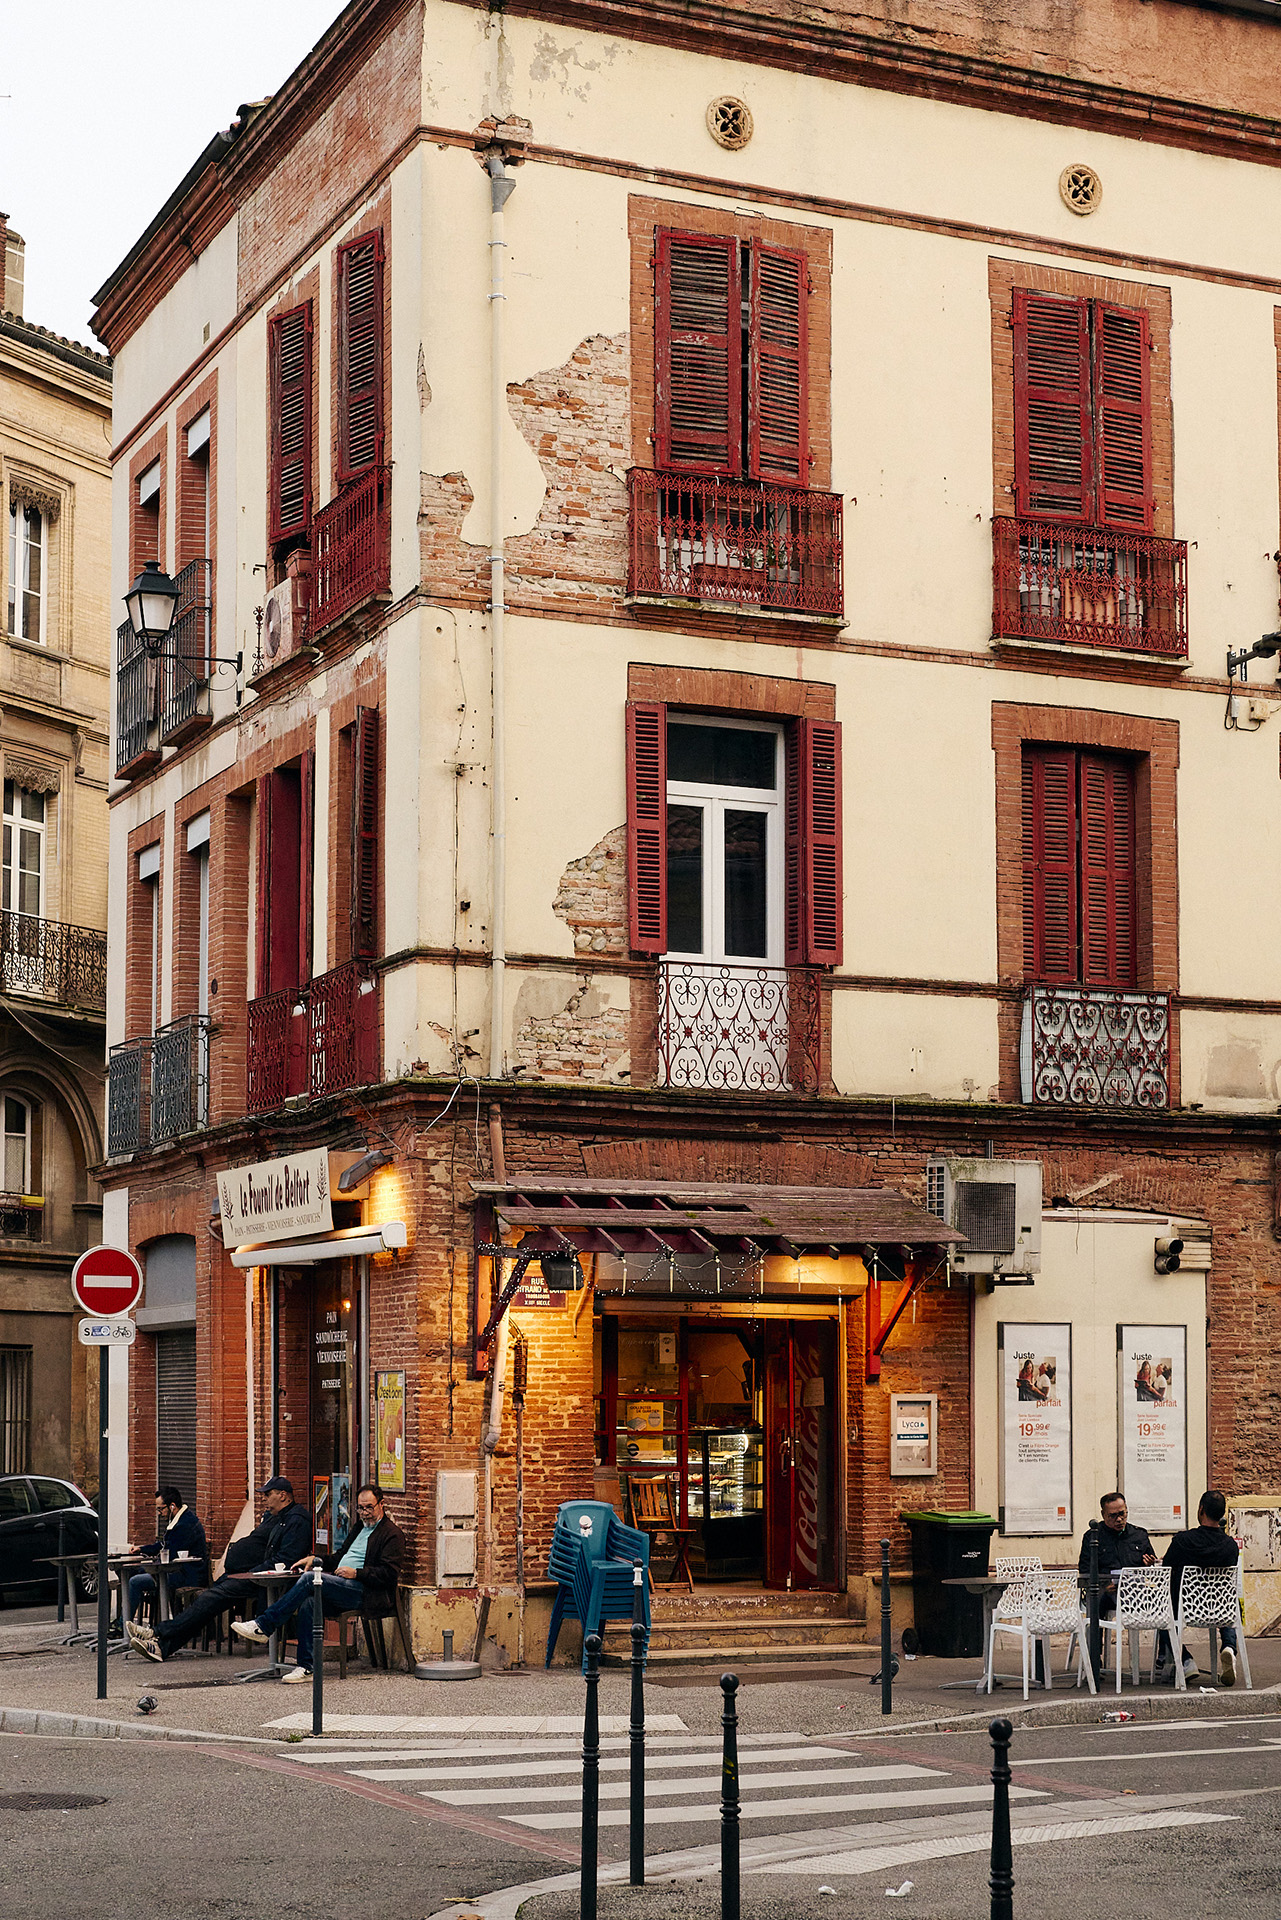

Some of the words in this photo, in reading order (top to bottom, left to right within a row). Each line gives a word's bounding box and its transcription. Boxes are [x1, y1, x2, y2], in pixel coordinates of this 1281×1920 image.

[240, 1183, 248, 1217] Le
[248, 1172, 274, 1215] Fournil
[275, 1174, 283, 1211] de
[284, 1164, 310, 1208] Belfort
[530, 1277, 545, 1286] RUE
[326, 1311, 337, 1324] PAIN
[315, 1330, 348, 1344] SANDWICHERIE
[316, 1350, 346, 1363] VIENNOISERIE
[1013, 1351, 1035, 1360] Juste
[1131, 1352, 1152, 1361] Juste
[1036, 1398, 1062, 1408] parfait
[1153, 1399, 1177, 1409] parfait
[902, 1420, 920, 1430] Lyca
